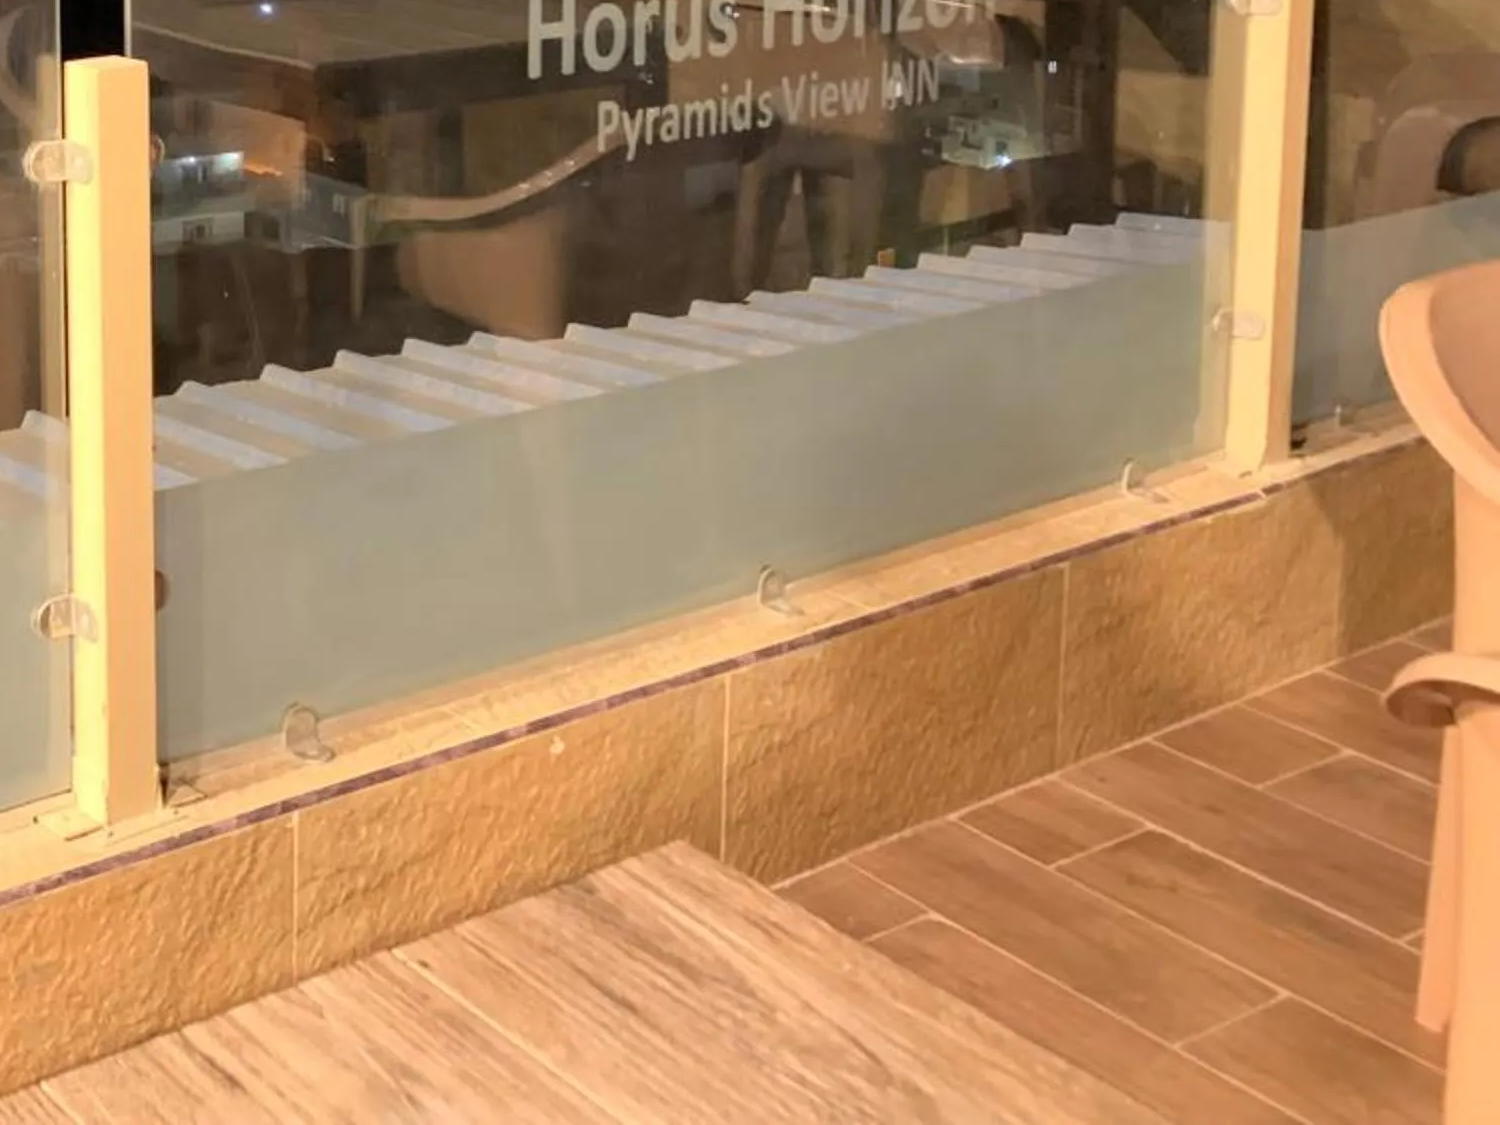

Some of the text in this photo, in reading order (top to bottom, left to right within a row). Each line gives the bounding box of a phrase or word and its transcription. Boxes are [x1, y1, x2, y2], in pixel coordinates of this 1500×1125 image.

[597, 57, 940, 162] Pyramids View INN
